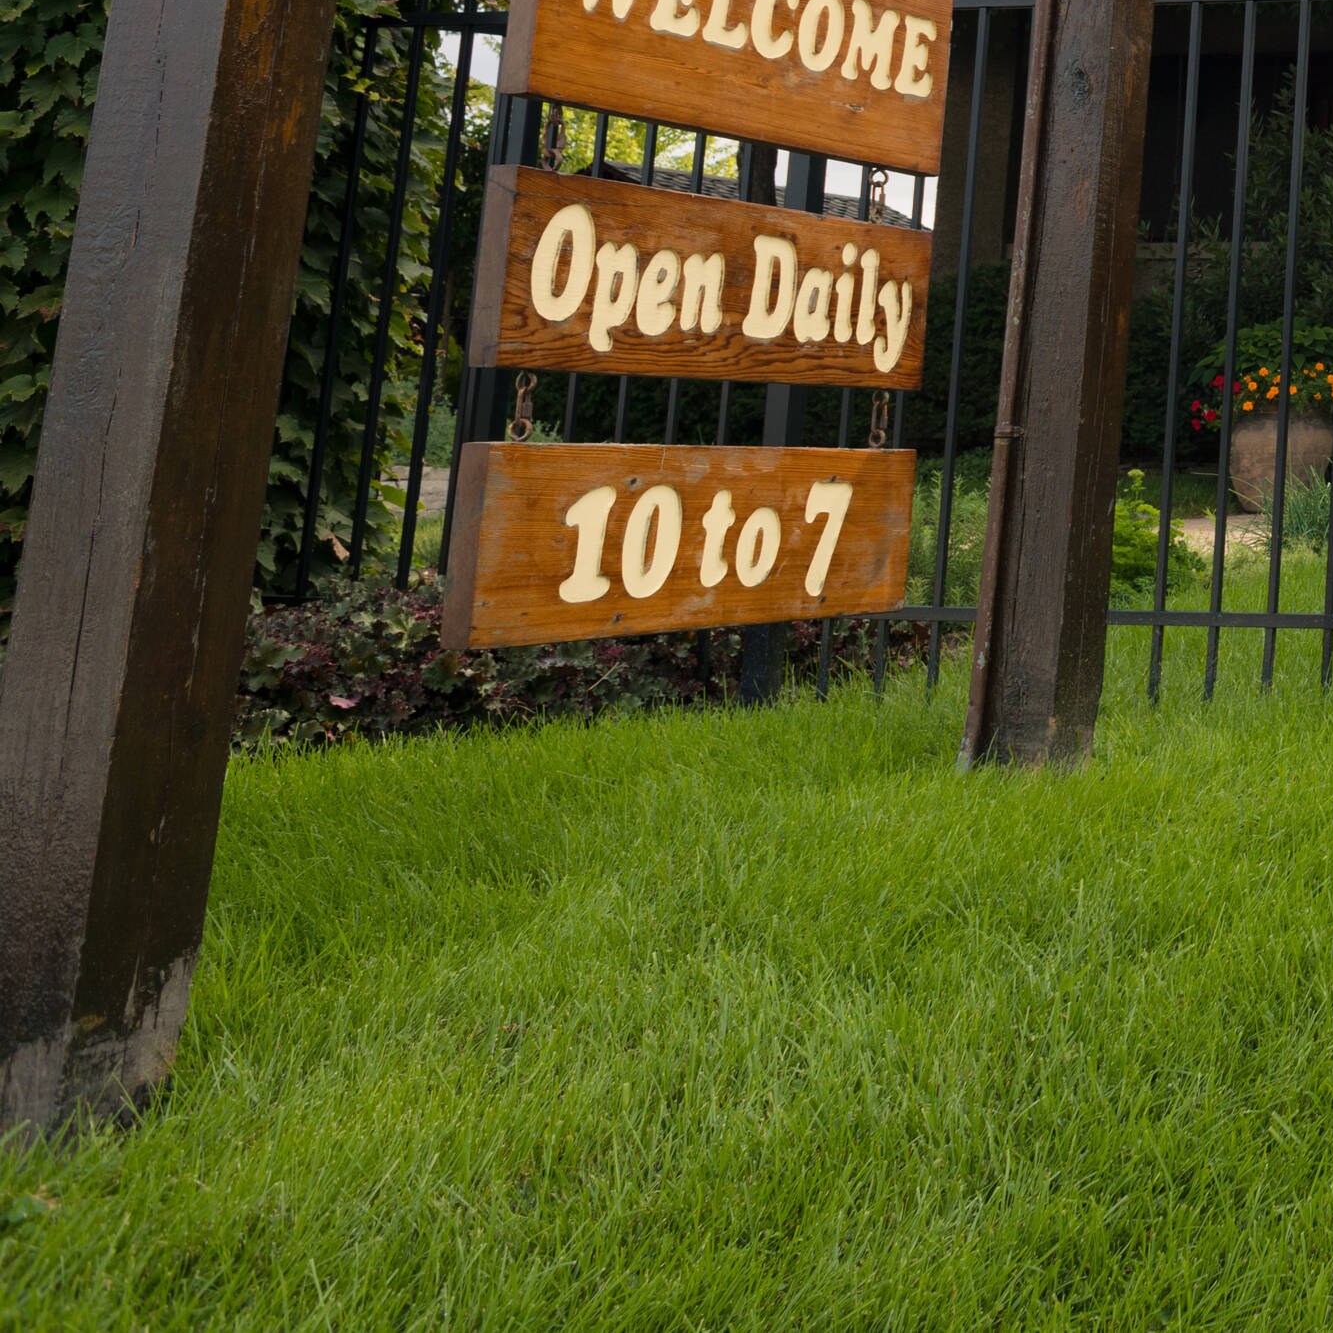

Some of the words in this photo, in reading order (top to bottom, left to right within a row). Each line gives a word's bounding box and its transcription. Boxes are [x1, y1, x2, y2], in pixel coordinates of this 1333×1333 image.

[531, 203, 725, 352] Open
[742, 234, 912, 373] Daily
[559, 484, 682, 603] 10
[700, 489, 781, 587] to
[804, 481, 853, 597] 7
